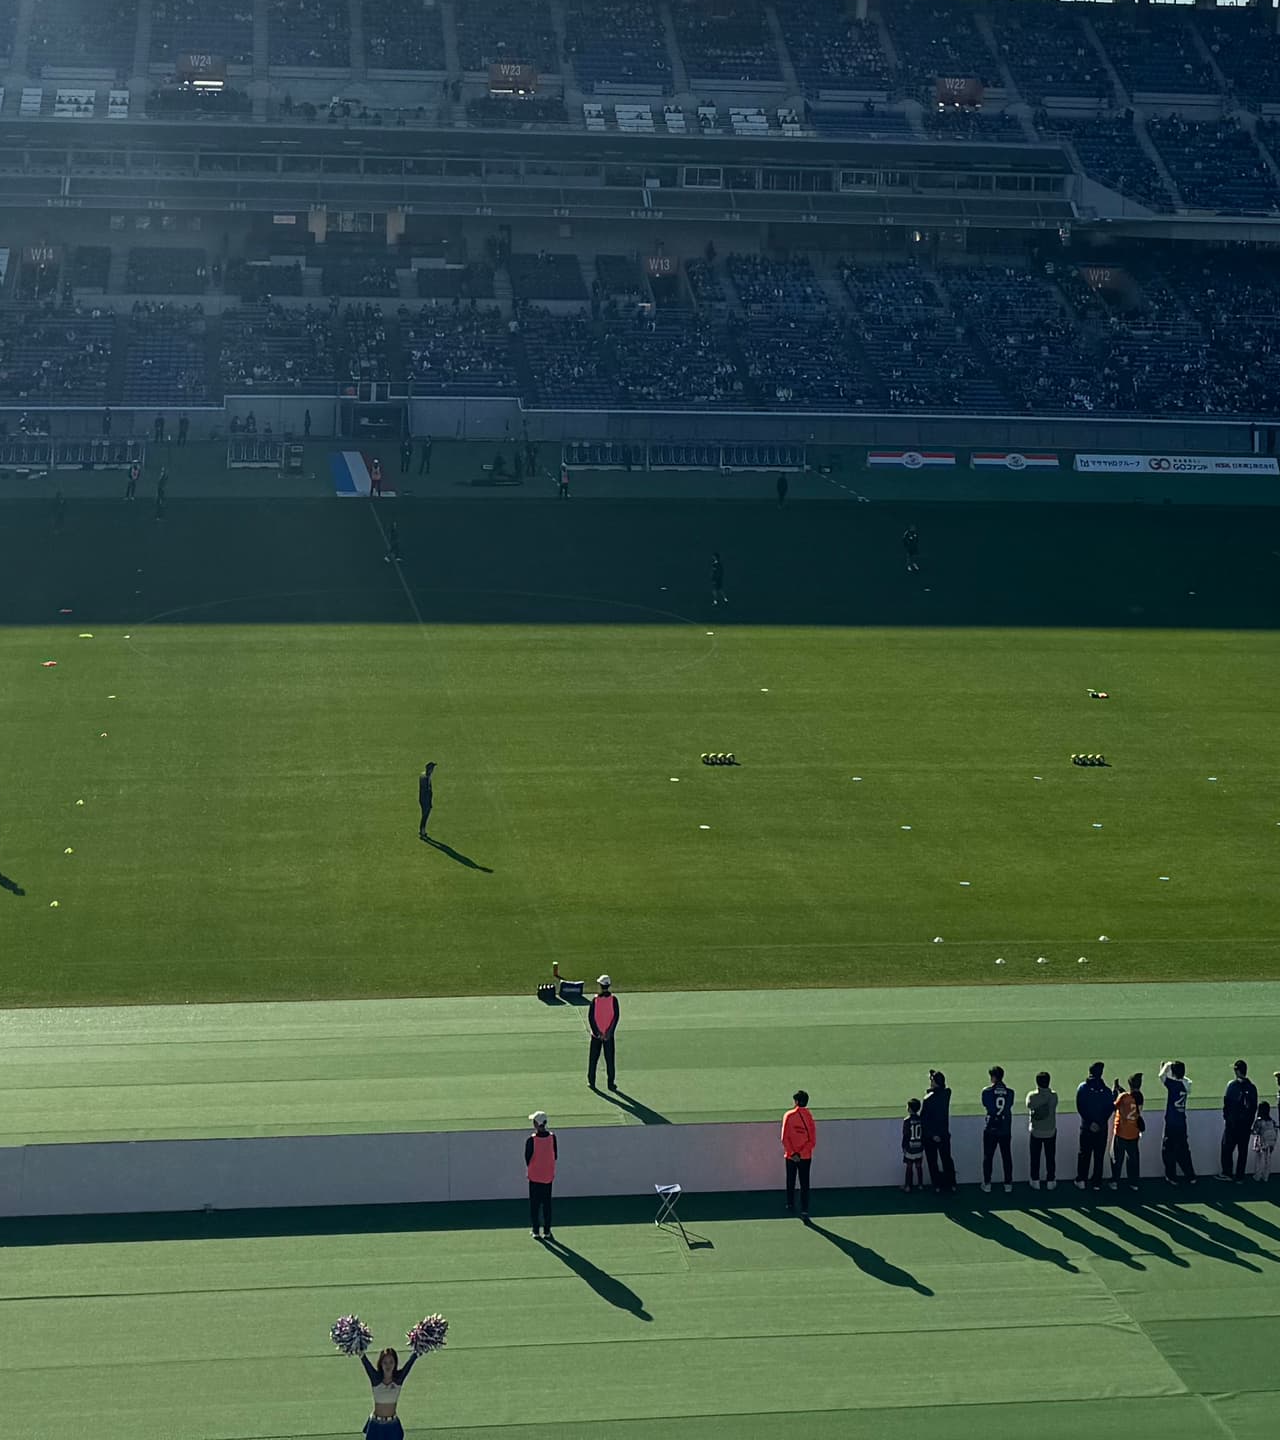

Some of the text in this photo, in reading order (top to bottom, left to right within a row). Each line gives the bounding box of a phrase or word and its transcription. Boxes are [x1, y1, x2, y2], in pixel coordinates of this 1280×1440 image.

[190, 55, 212, 67] W24
[500, 64, 521, 76] W23
[945, 78, 966, 89] W22
[31, 248, 53, 261] W14
[649, 258, 671, 271] W13
[1089, 269, 1111, 281] W12
[995, 1097, 1006, 1116] 9
[910, 1124, 922, 1140] 10
